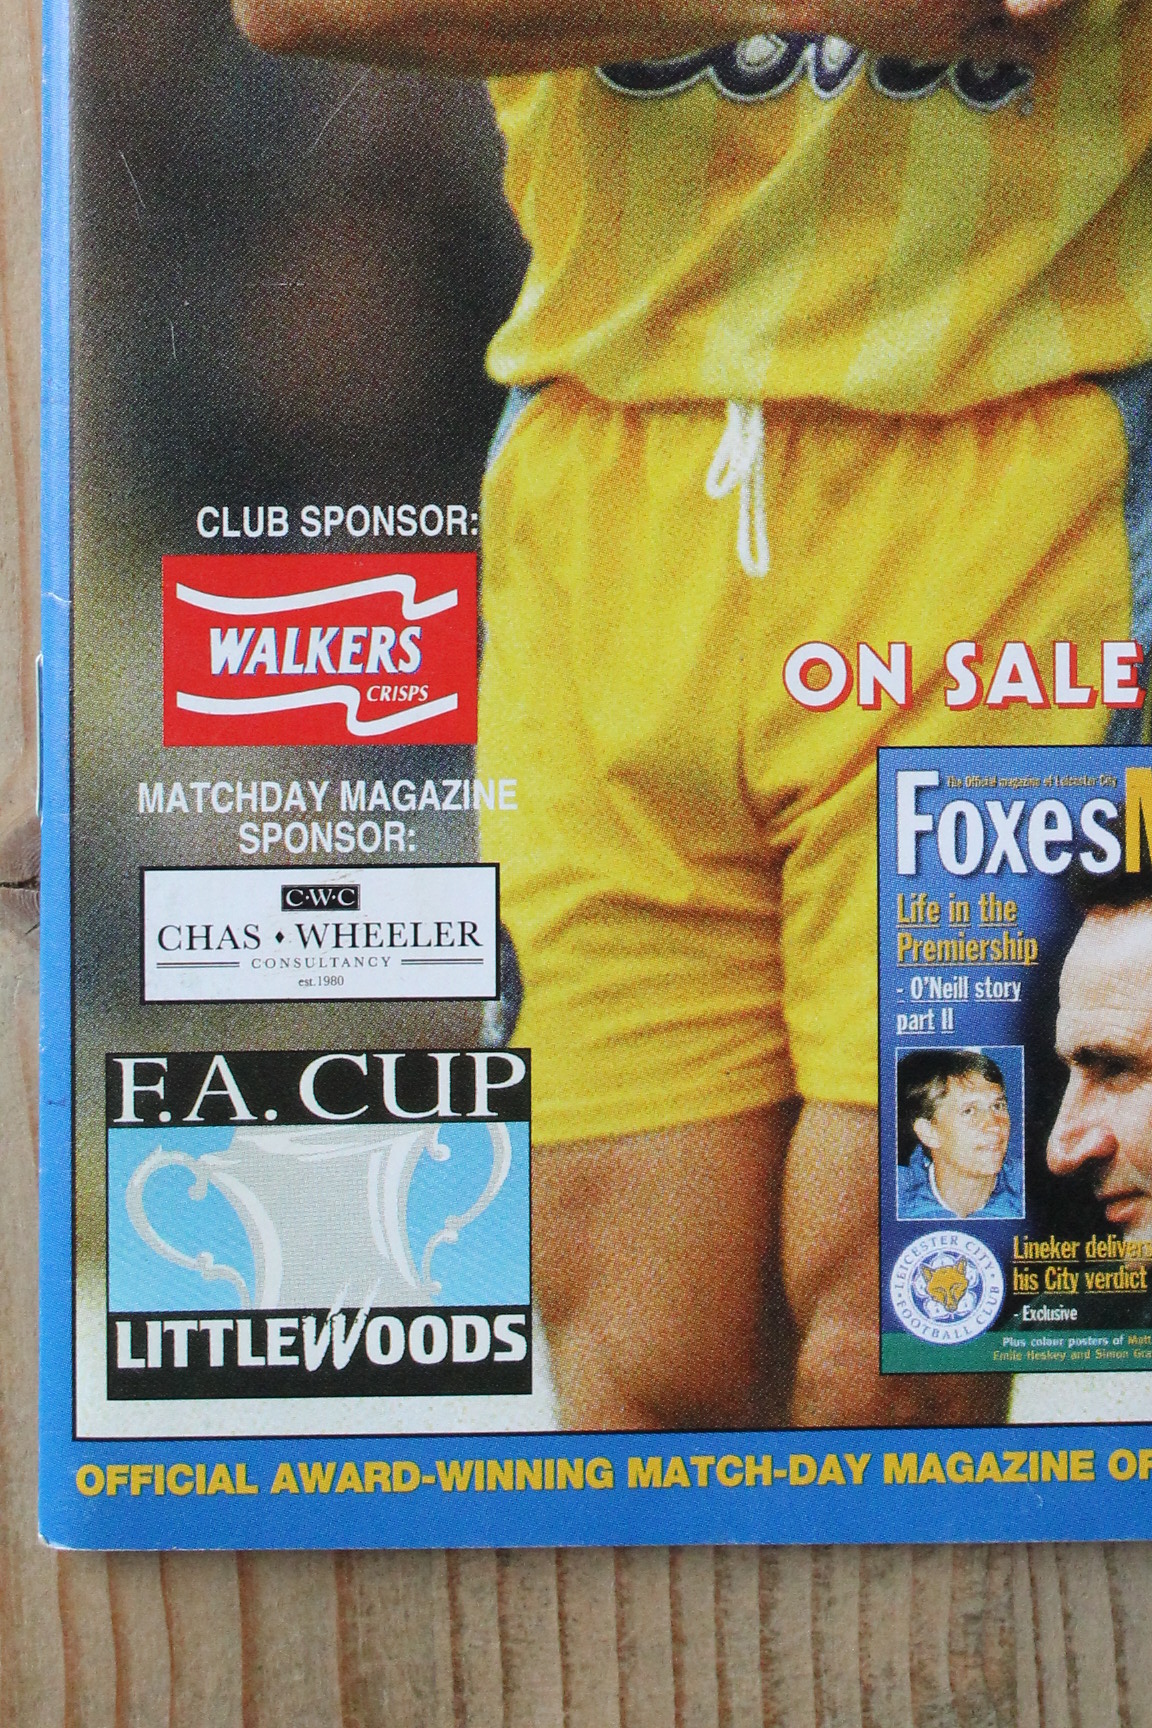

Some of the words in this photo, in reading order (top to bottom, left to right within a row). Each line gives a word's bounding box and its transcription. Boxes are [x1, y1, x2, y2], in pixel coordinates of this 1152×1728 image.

[198, 506, 289, 538] CLUB
[300, 505, 479, 537] SPONSOR:
[209, 626, 423, 676] WALKERS
[782, 641, 914, 712] ON
[944, 641, 1146, 711] SALE
[367, 685, 429, 702] CRISPS
[138, 781, 330, 813] MATCHDAY
[340, 779, 518, 812] MAGAZINE
[239, 822, 416, 854] SPONSOR:
[897, 893, 940, 924] Life
[949, 894, 970, 923] in
[979, 893, 1018, 923] the
[157, 924, 261, 951] CHAS
[299, 920, 483, 949] WHEELER
[897, 931, 1039, 966] Premiership
[251, 957, 392, 969] CONSULTANCY
[910, 976, 969, 1001] O'Neill
[975, 976, 1021, 1001] story
[897, 1009, 935, 1033] part
[113, 1054, 278, 1123] F.A.
[299, 1052, 526, 1121] CUP
[895, 1235, 958, 1289] LEICESTER
[966, 1241, 995, 1270] CITY
[1012, 1235, 1080, 1261] Lineker
[1012, 1266, 1039, 1292] his
[1045, 1266, 1079, 1293] City
[1085, 1265, 1147, 1291] verdict
[897, 1300, 973, 1340] FOOTBALL
[976, 1286, 1000, 1325] CLUB
[1022, 1304, 1078, 1321] Exclusive
[115, 1313, 527, 1372] LITTLEWOODS
[75, 1462, 259, 1497] OFFICIAL
[271, 1456, 615, 1496] AWARD-WINNING
[627, 1452, 871, 1489] MATCH-DAY
[883, 1450, 1096, 1485] MAGAZINE
